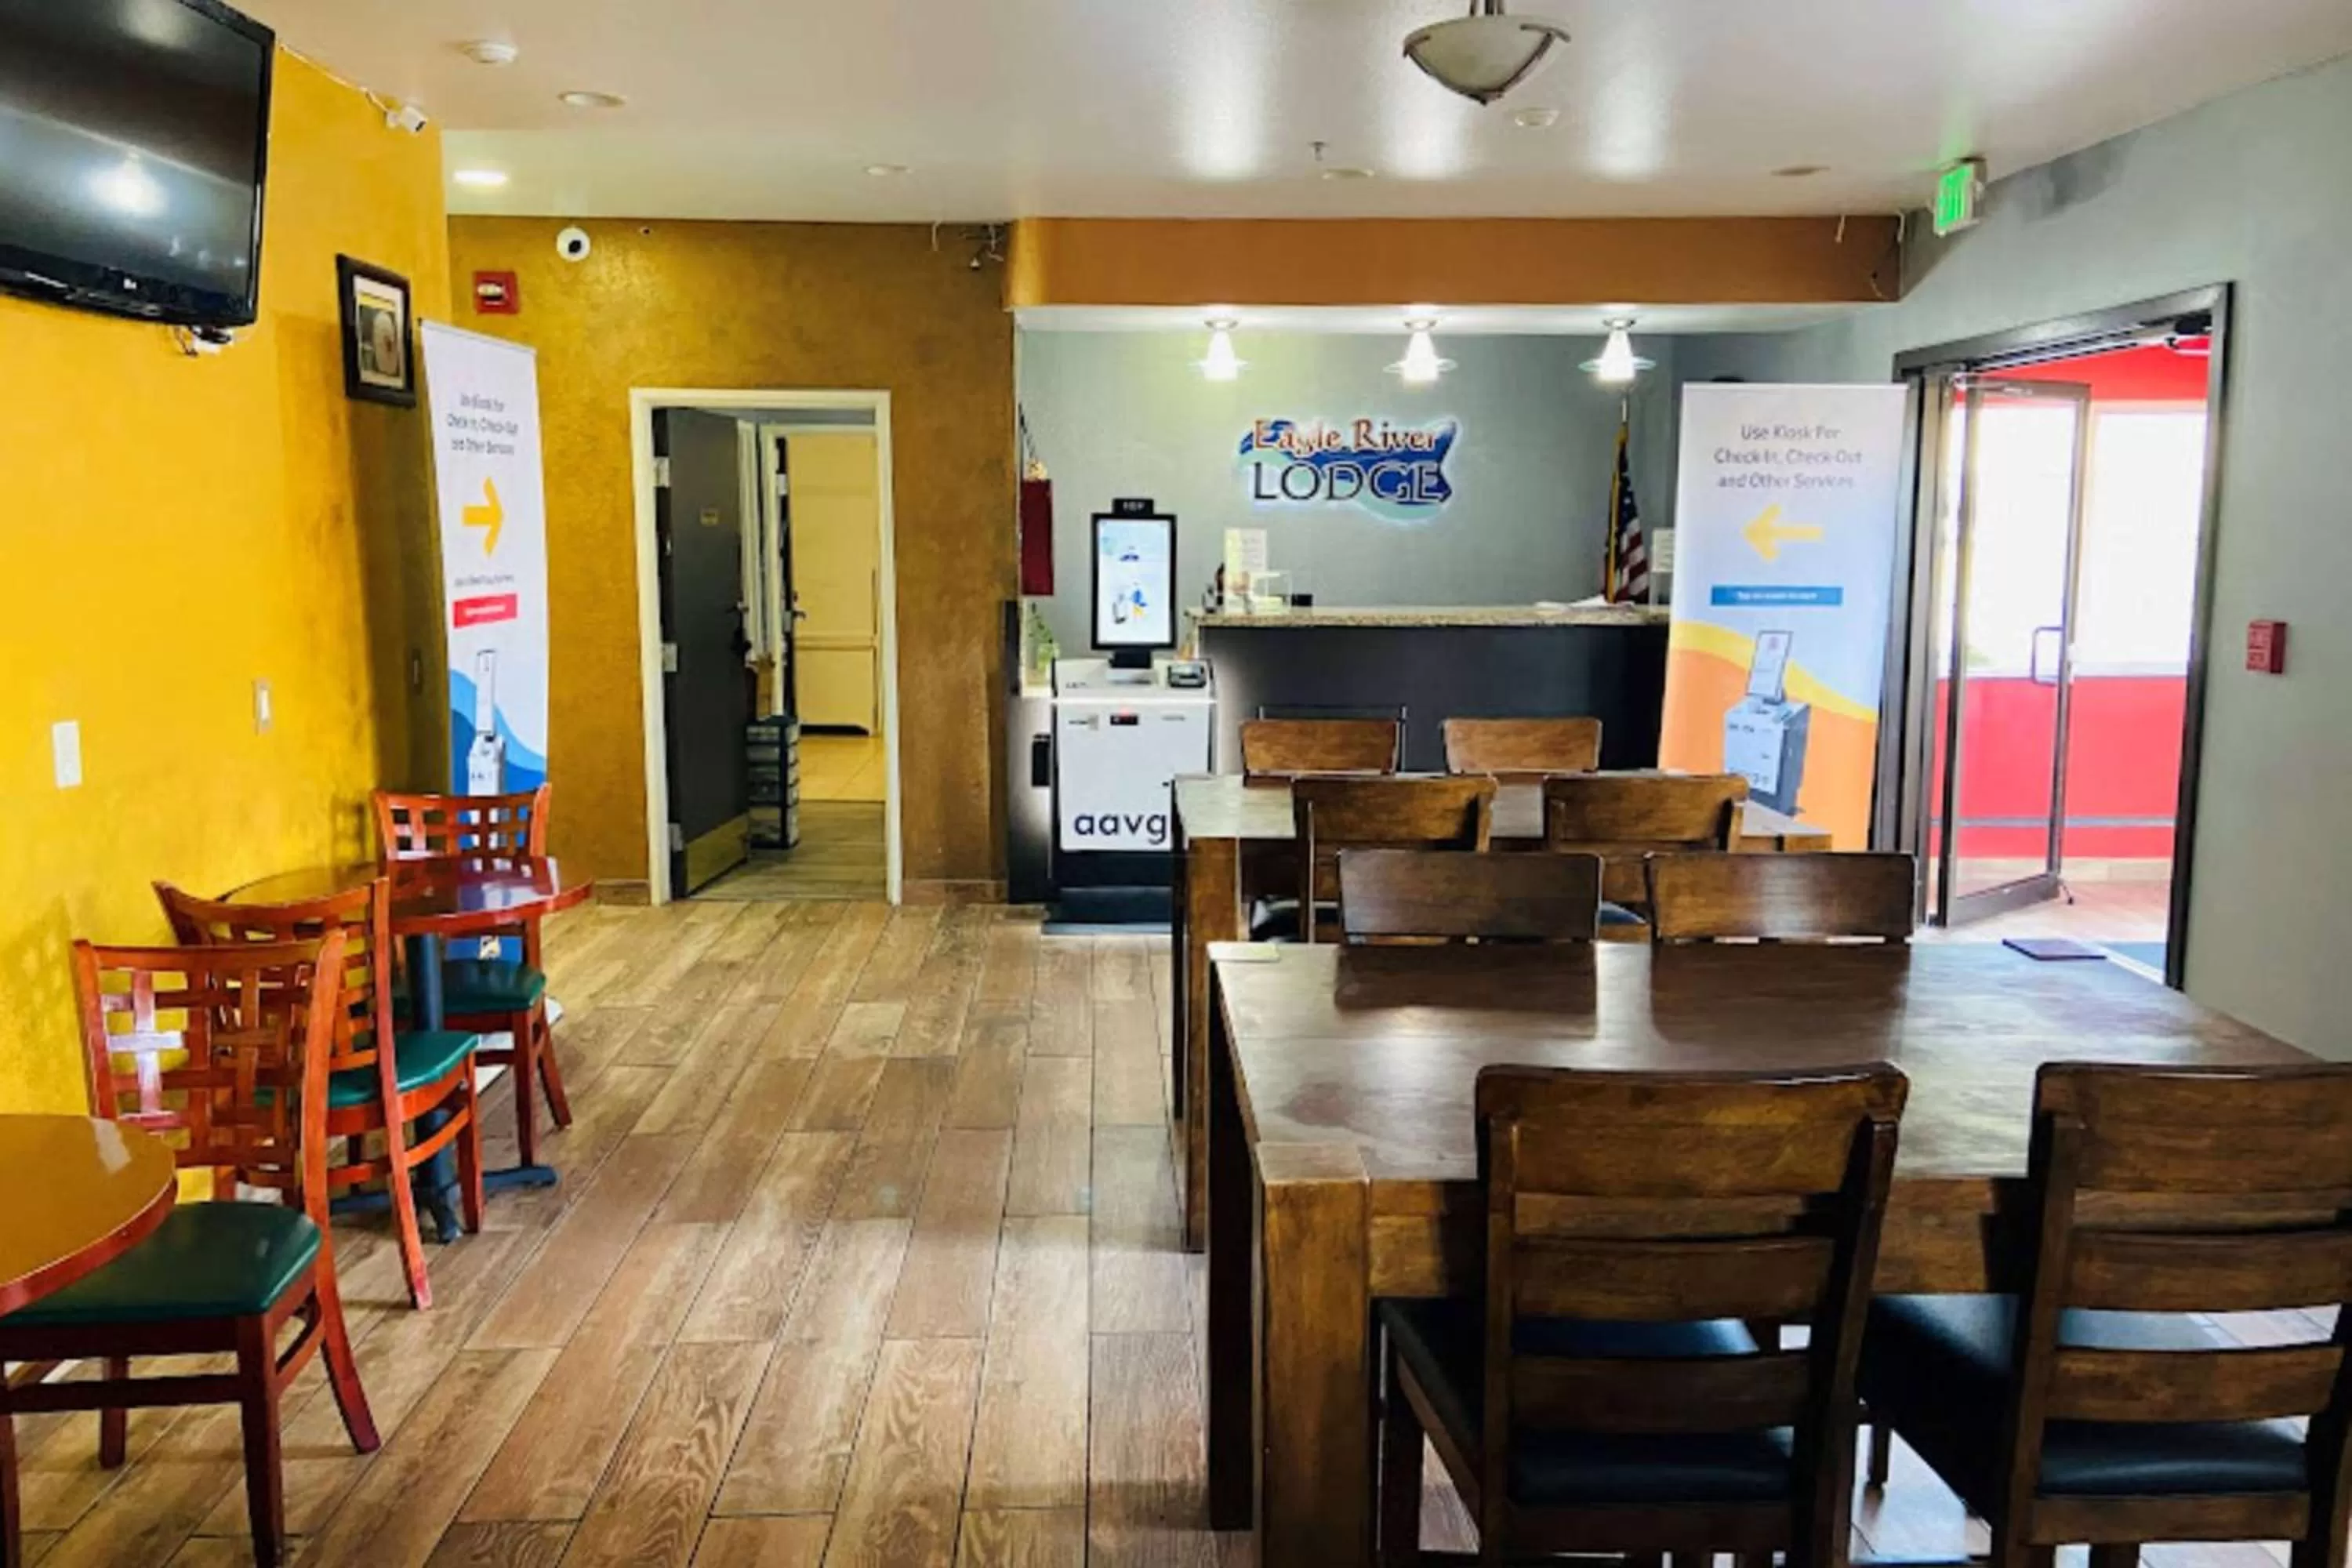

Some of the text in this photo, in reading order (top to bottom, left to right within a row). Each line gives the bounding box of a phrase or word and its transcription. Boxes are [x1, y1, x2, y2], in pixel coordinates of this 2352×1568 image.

[1254, 419, 1436, 455] Eagle River
[1740, 425, 1769, 441] Use
[1254, 462, 1453, 504] LODGE
[1749, 471, 1790, 489] Other
[1073, 815, 1167, 845] aavg
